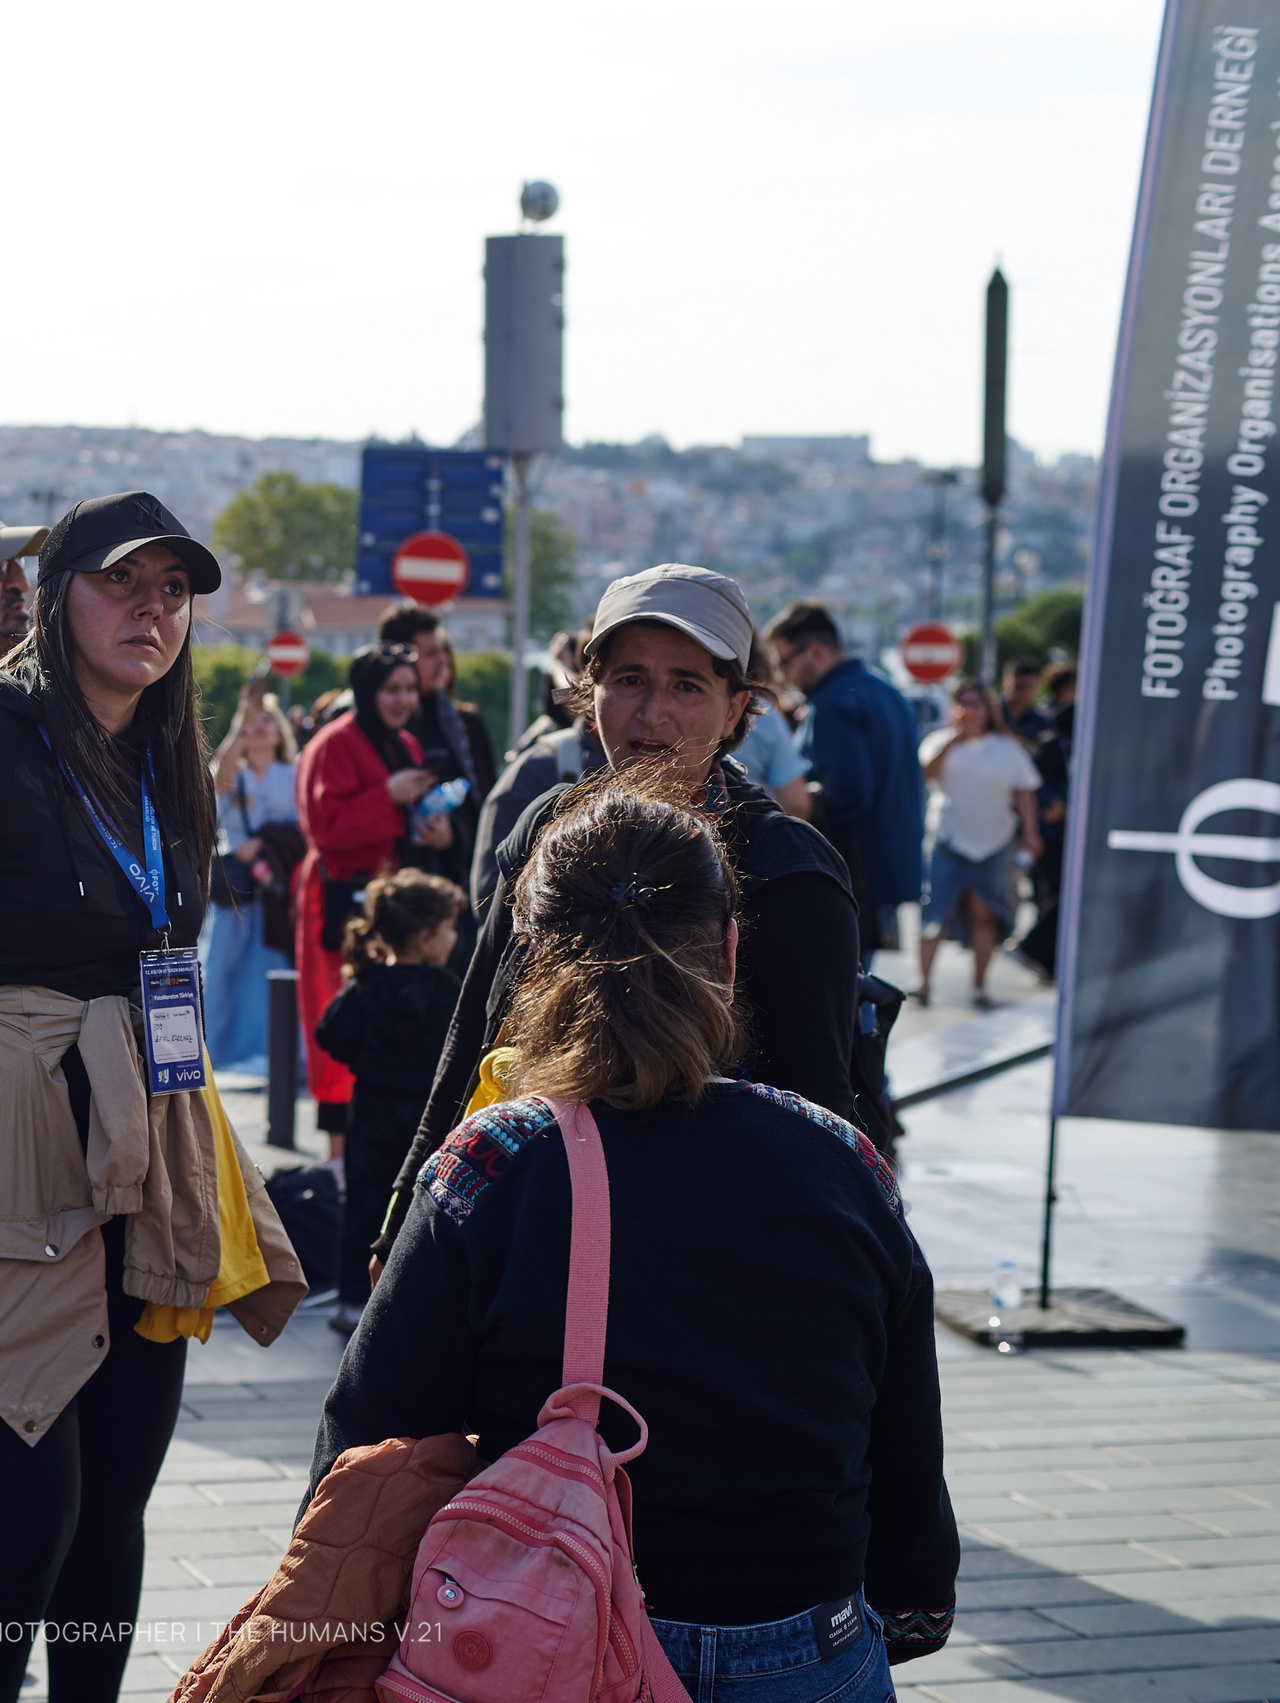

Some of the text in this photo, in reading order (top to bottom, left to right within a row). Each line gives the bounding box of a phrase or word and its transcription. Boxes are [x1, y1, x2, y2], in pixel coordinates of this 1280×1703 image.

[1141, 25, 1261, 698] FOTOĞRAF ORGANİZASYONLARI DERNEĞİ
[1202, 243, 1280, 700] Photography Organisations
[129, 863, 155, 903] vivo
[176, 1069, 201, 1082] vivo
[830, 1600, 853, 1627] mavi
